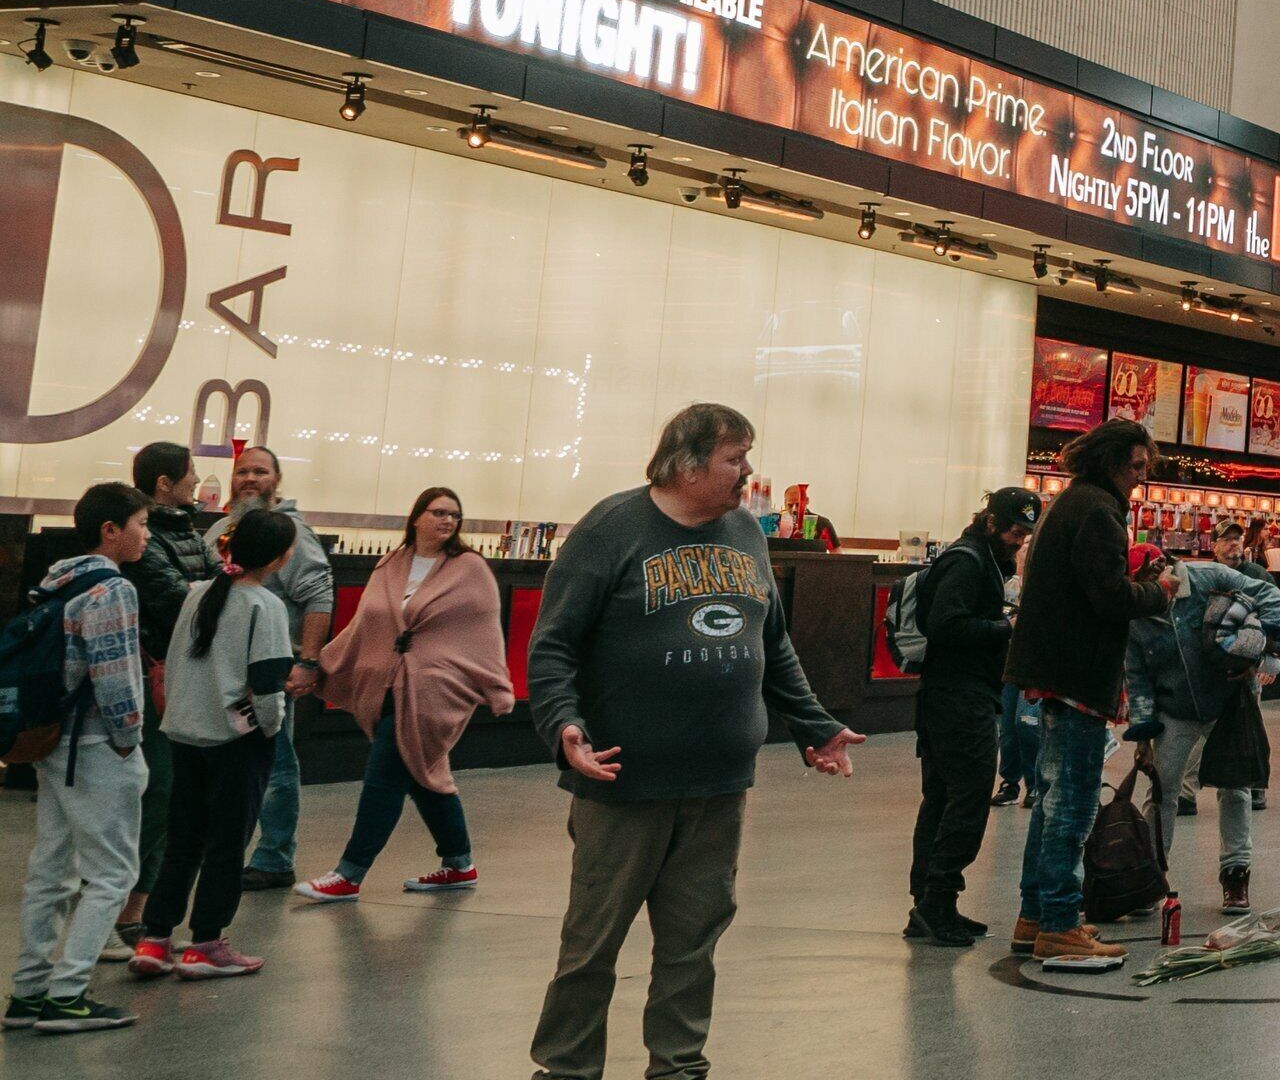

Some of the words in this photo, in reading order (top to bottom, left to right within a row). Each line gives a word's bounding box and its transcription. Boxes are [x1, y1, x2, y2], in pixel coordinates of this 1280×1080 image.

[806, 22, 959, 109] American
[968, 75, 1047, 137] Prime.
[829, 87, 918, 152] Italian
[927, 118, 1011, 180] Flavor.
[1124, 177, 1170, 226] 5PM
[1186, 196, 1235, 245] 11PM
[1245, 210, 1270, 259] the
[189, 148, 300, 460] BAR
